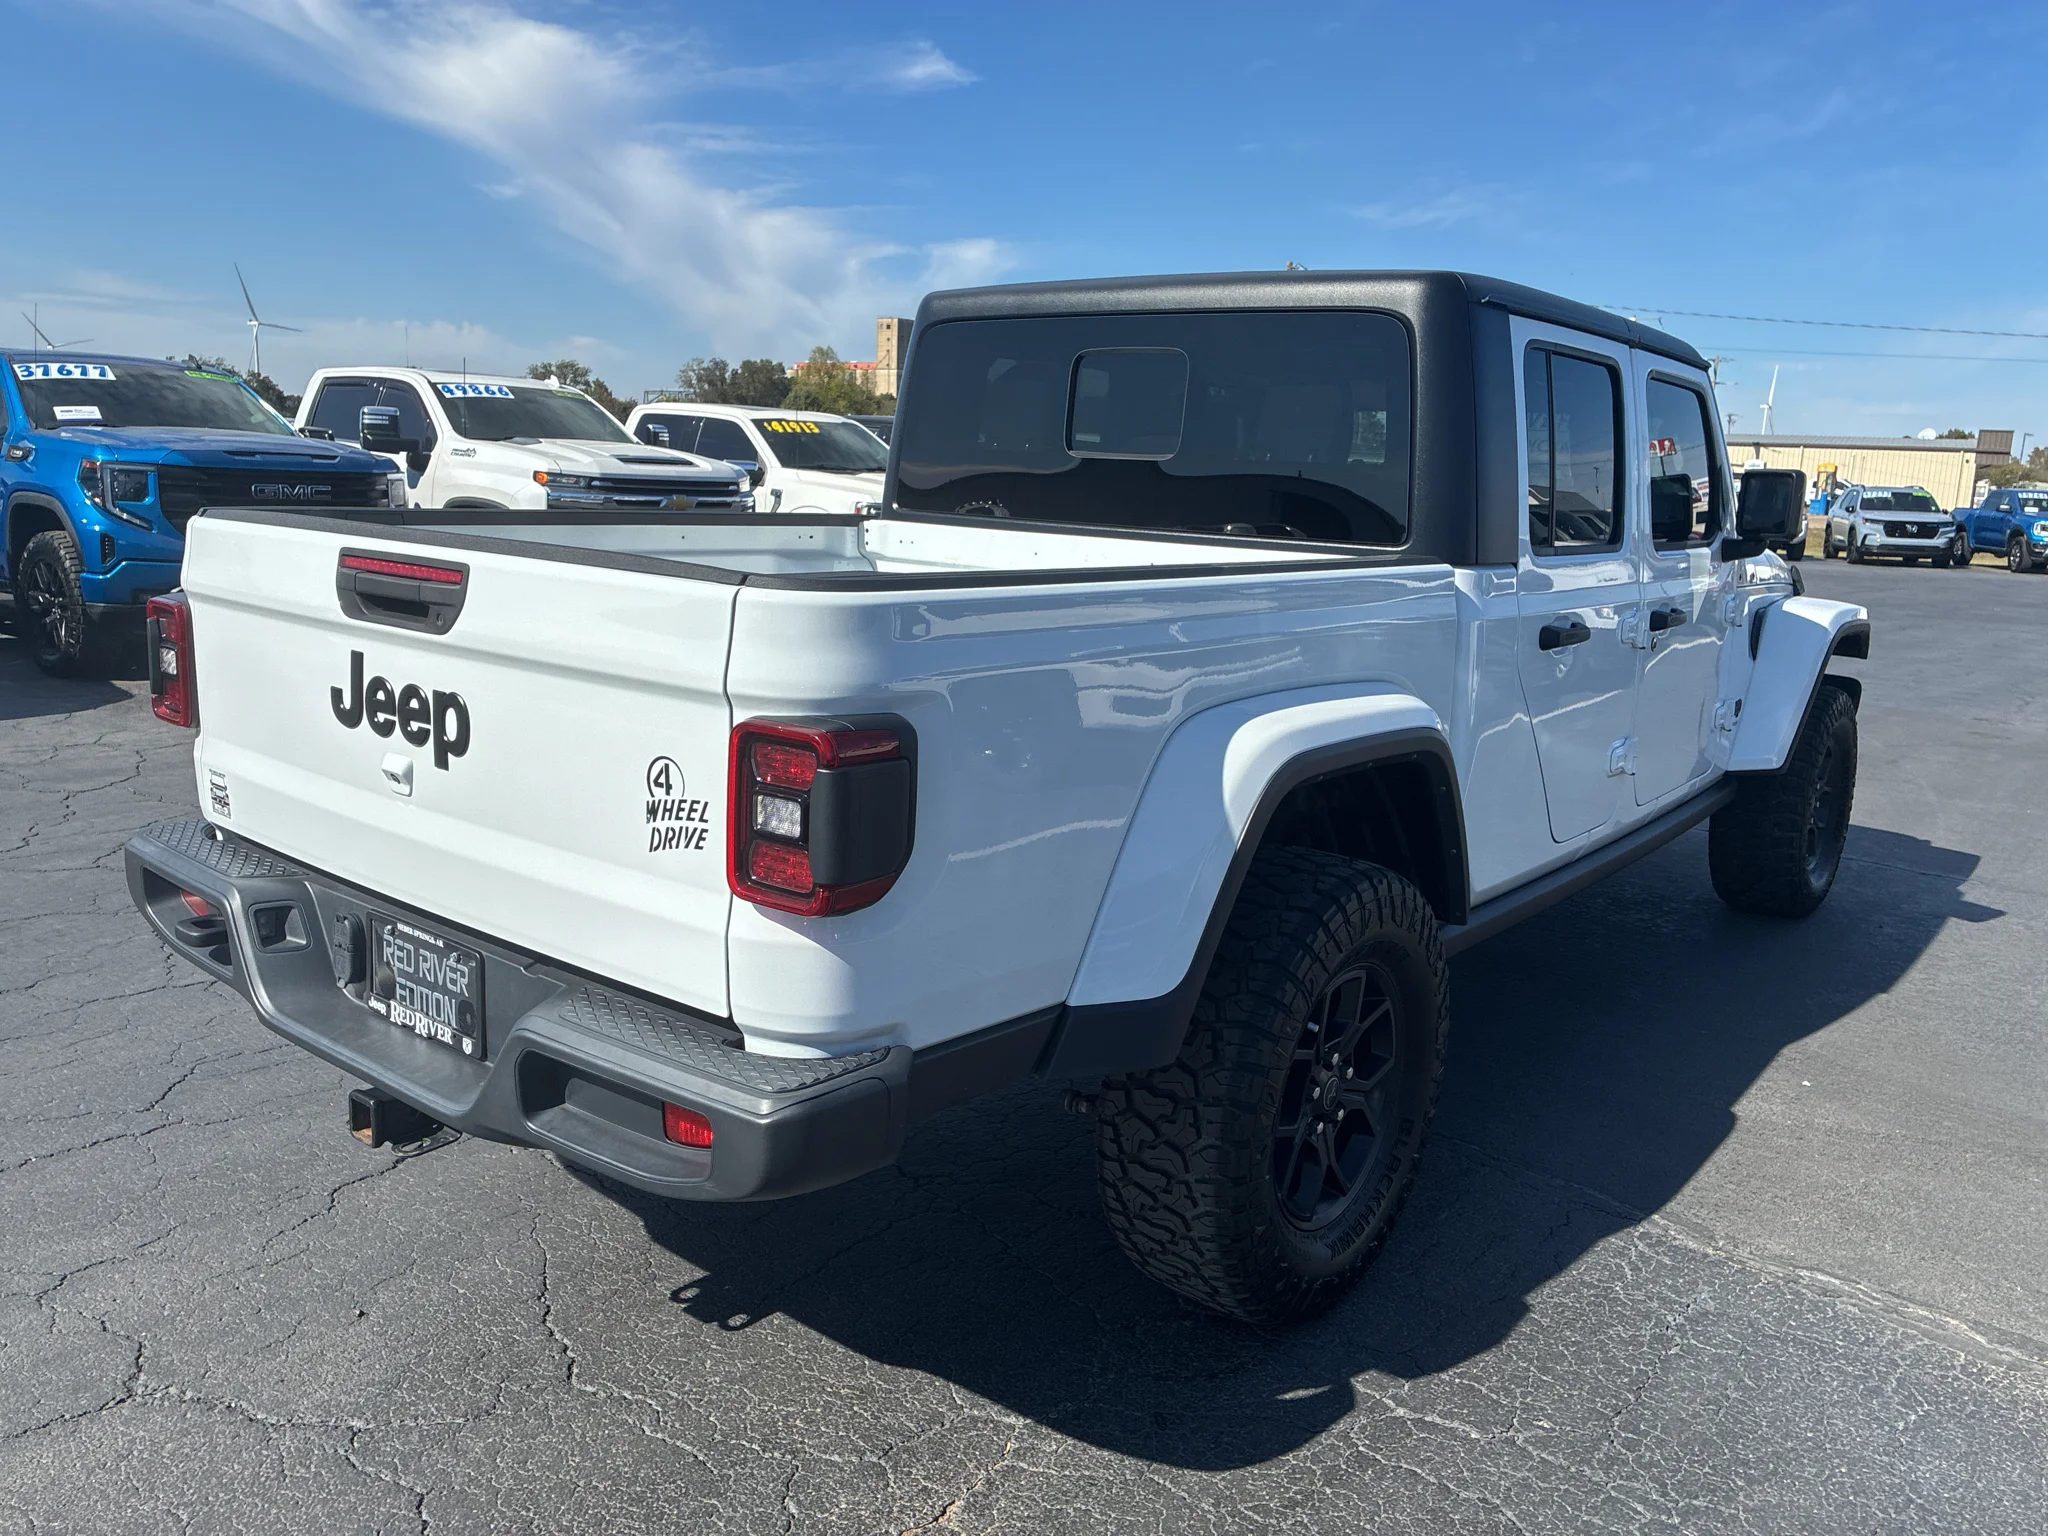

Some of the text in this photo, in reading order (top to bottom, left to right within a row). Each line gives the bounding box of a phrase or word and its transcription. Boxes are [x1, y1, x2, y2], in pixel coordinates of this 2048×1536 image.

[17, 364, 107, 378] 37677
[441, 384, 510, 397] 49866
[251, 483, 332, 500] GMC
[330, 649, 471, 772] Jeep
[652, 762, 673, 797] 4
[646, 798, 709, 824] WHEEL
[648, 825, 709, 853] DRIVE
[383, 934, 415, 974] RED
[419, 948, 470, 998] RIVER
[368, 996, 387, 1016] Jeep
[396, 976, 457, 1029] EDITION
[1325, 1117, 1415, 1261] BLACKHAWK
